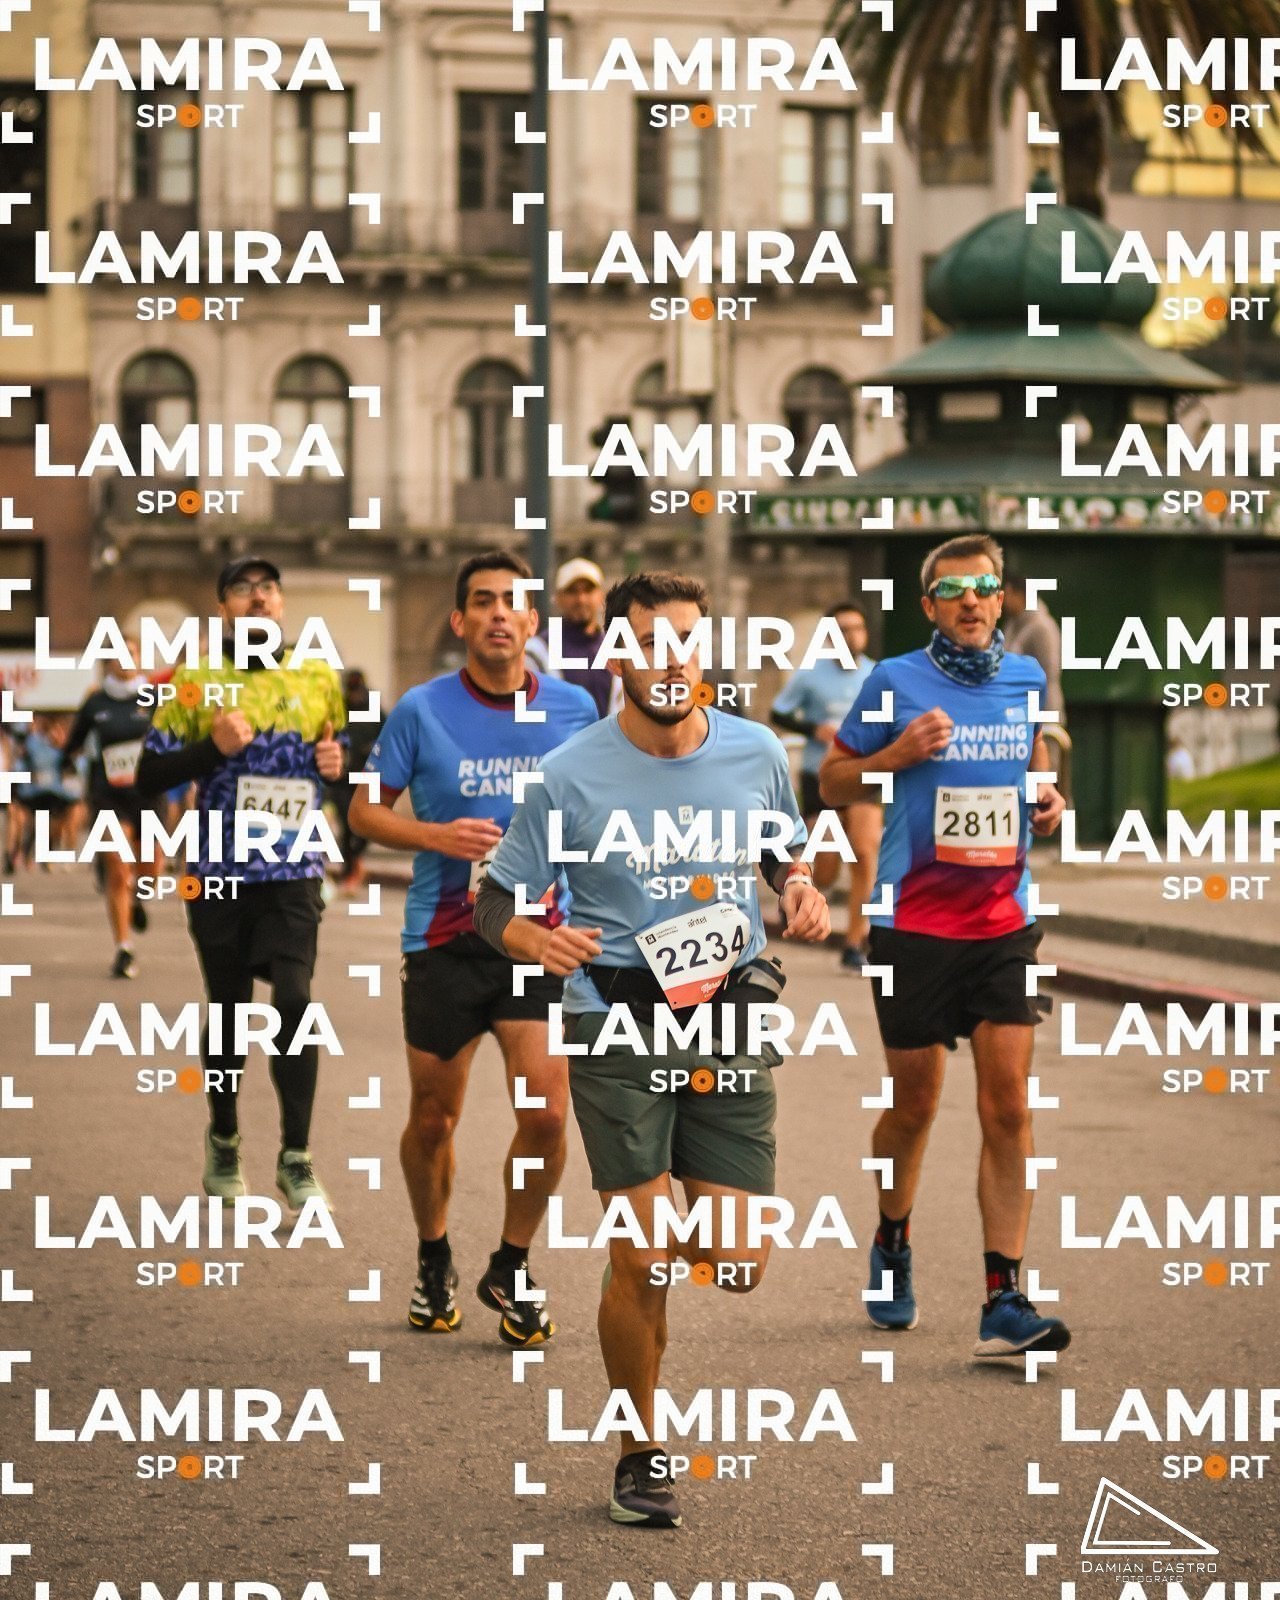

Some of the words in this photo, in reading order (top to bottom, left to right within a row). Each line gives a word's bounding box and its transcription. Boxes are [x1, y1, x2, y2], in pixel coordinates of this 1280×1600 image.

[950, 723, 1028, 744] UNNING
[458, 755, 543, 779] RUNNI
[460, 777, 513, 798] CAN
[242, 796, 307, 822] 6447
[942, 809, 1012, 837] 2811
[655, 925, 745, 979] 2234
